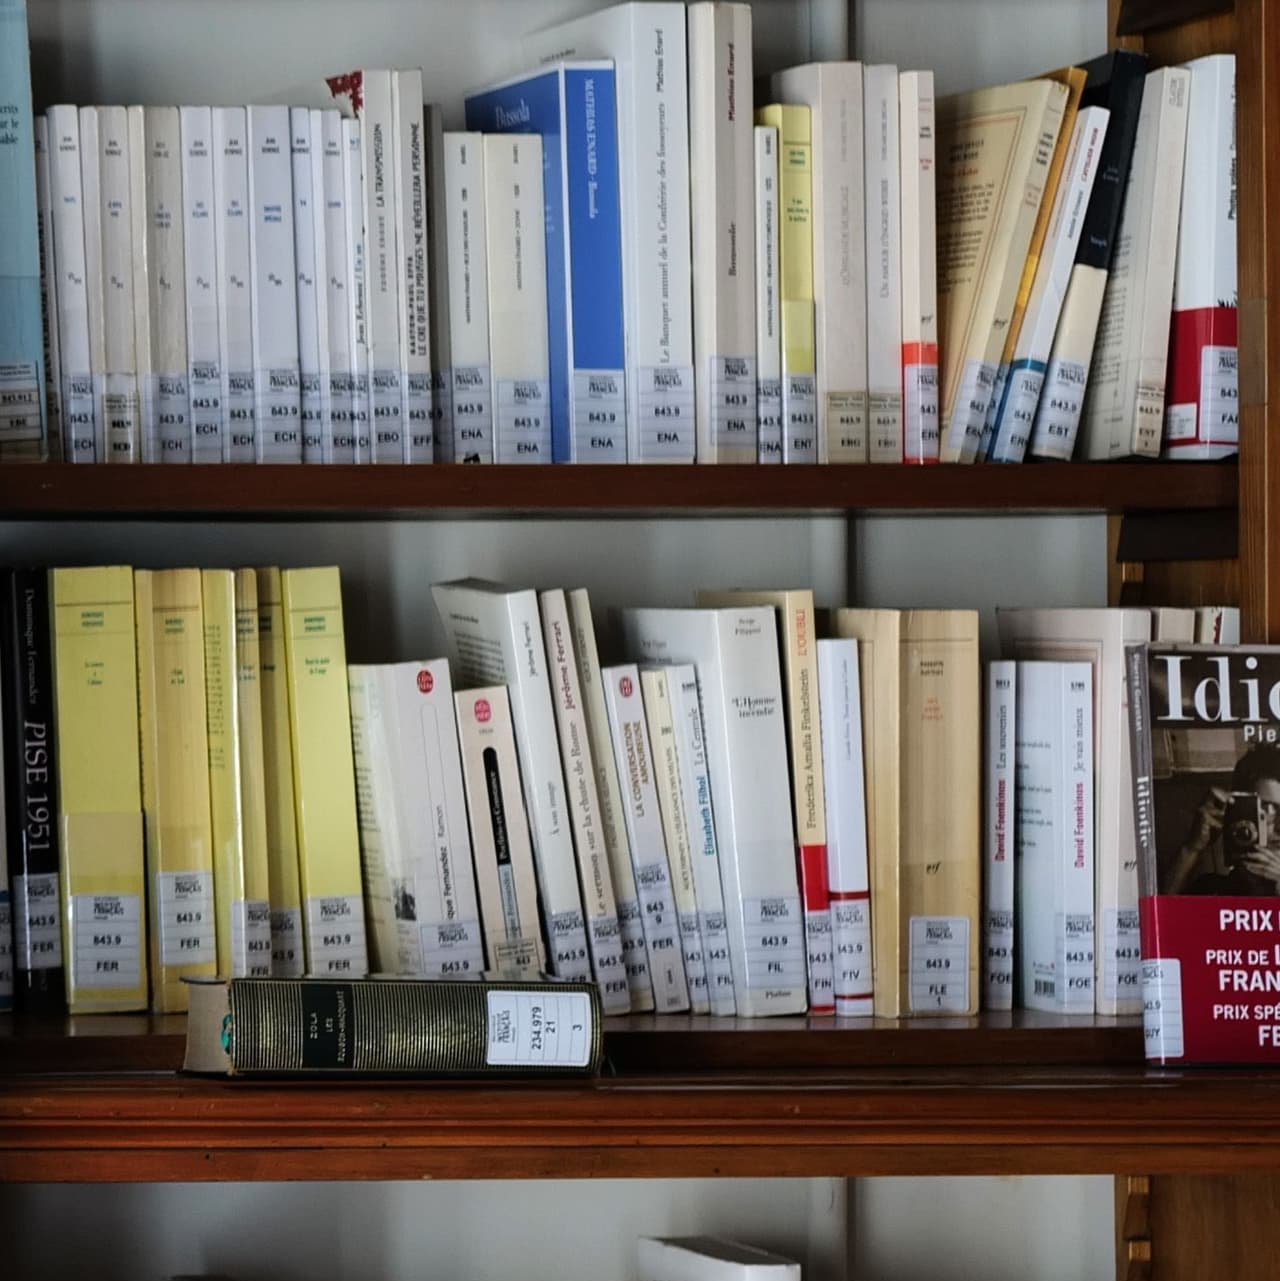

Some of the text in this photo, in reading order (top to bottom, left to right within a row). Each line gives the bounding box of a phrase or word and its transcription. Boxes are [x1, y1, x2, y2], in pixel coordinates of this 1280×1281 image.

[588, 413, 616, 423] 843.9
[591, 438, 613, 448] ENA
[552, 620, 576, 711] Jérôme Ferrari
[567, 720, 582, 756] Rome
[693, 752, 703, 765] La
[573, 760, 585, 775] de
[623, 722, 645, 817] LA CONVERSATION
[26, 721, 49, 850] PISE 1951
[576, 779, 591, 812] chute
[582, 816, 594, 828] la
[995, 779, 1006, 861] David Foenkinos
[700, 808, 715, 855] Élisabeth
[439, 847, 453, 897] Fernandez
[1219, 910, 1273, 931] PRIX
[94, 935, 121, 946] 843.9
[324, 935, 350, 945] 843.9
[1206, 950, 1269, 964] PRIX DE
[96, 961, 118, 971] FER
[328, 959, 350, 970] FER
[1214, 1006, 1249, 1019] PRIX
[531, 1006, 543, 1050] 234.979
[545, 1020, 557, 1034] 21
